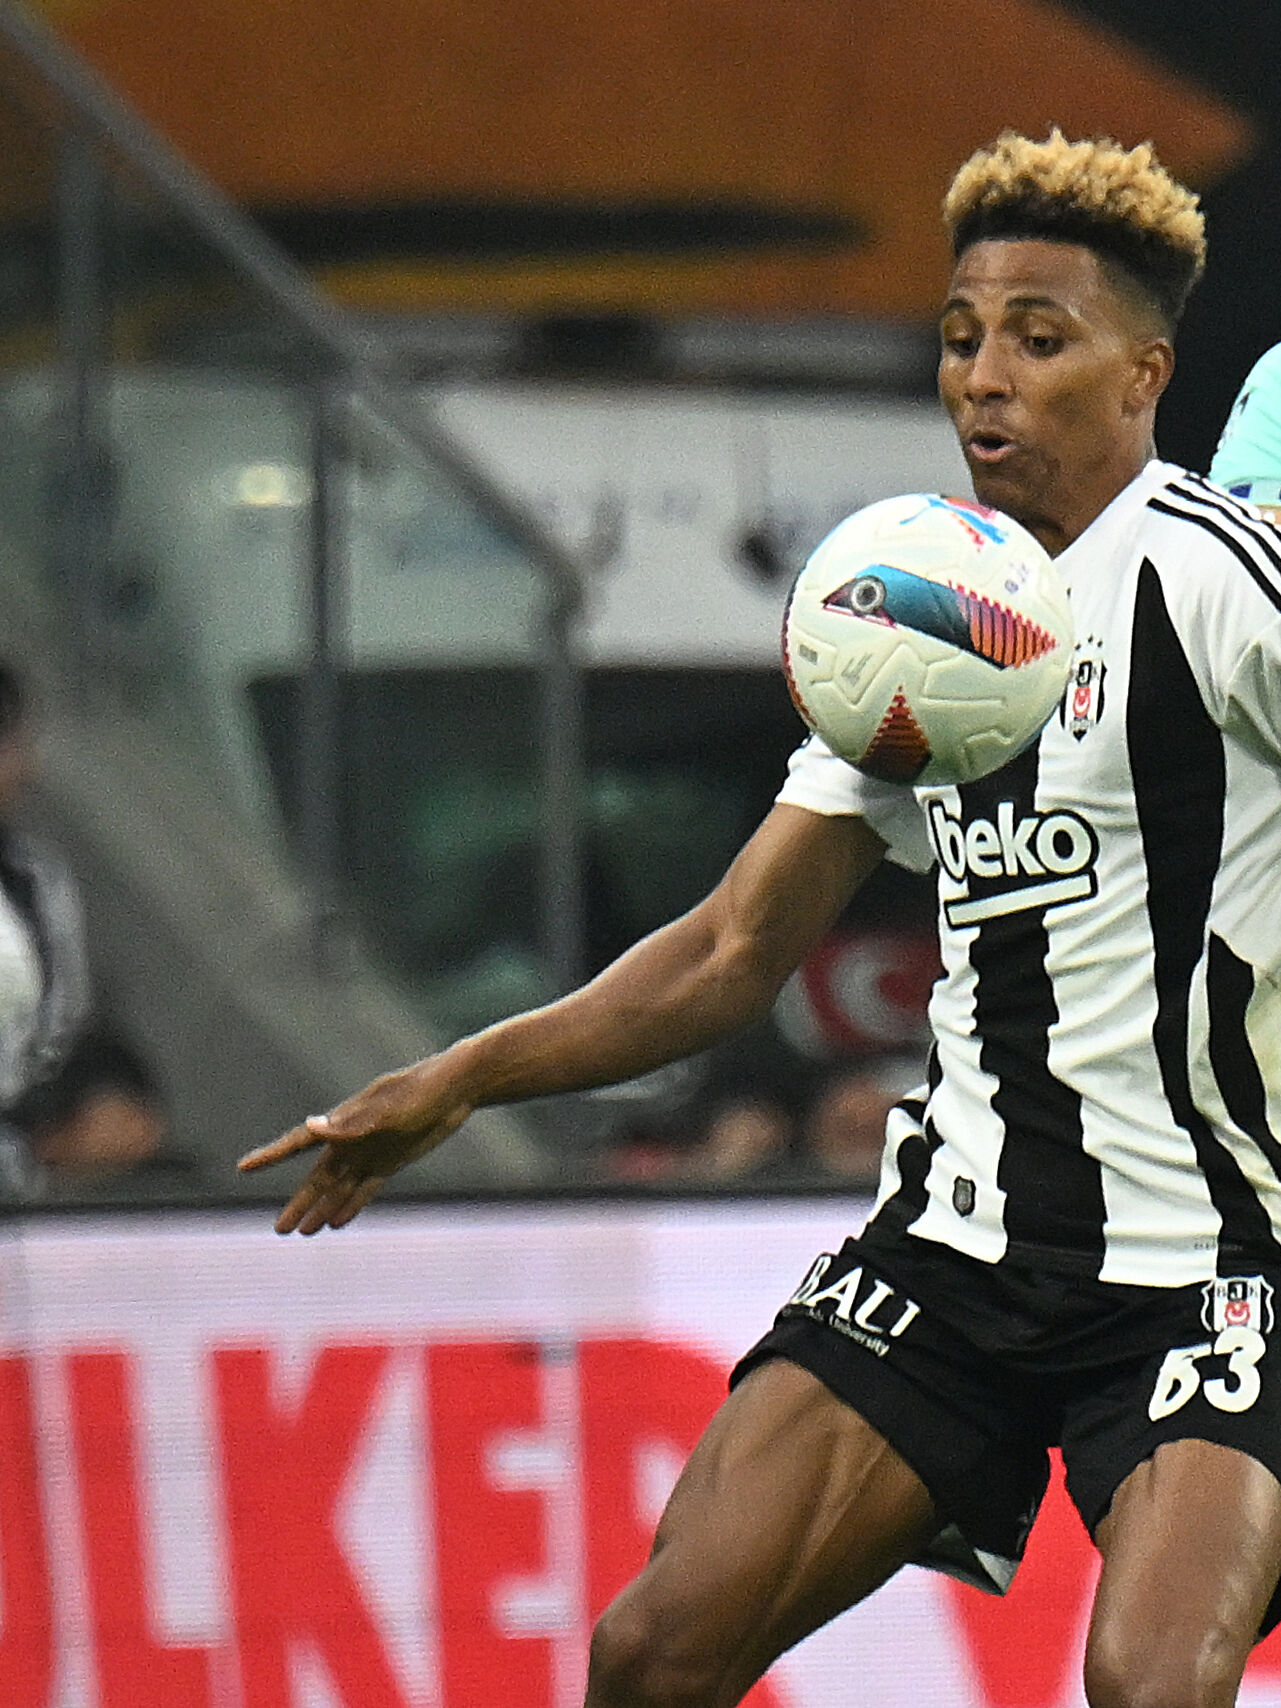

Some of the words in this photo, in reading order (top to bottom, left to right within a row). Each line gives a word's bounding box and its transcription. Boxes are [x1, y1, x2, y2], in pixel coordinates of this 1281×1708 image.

[930, 801, 1096, 880] beko
[1148, 1324, 1266, 1422] 63
[0, 1335, 795, 1708] LKER
